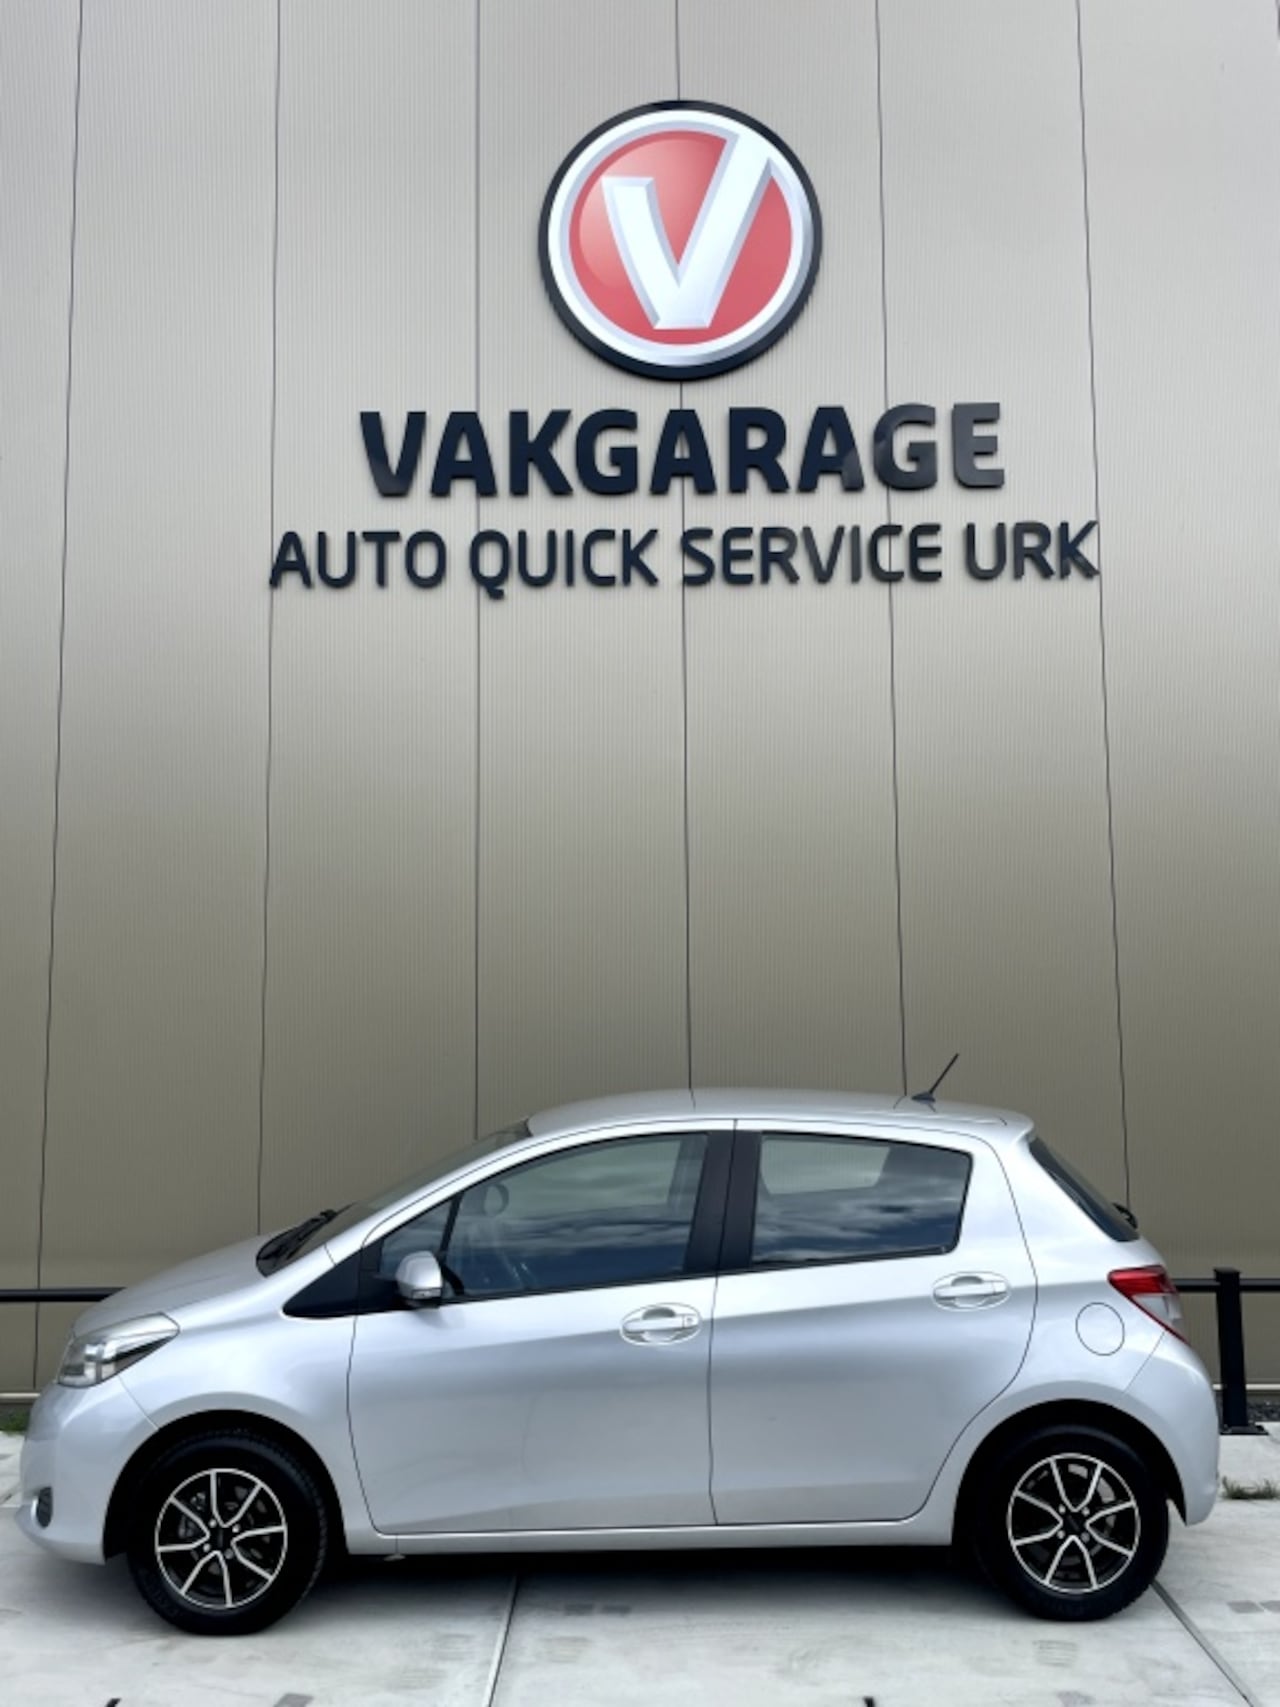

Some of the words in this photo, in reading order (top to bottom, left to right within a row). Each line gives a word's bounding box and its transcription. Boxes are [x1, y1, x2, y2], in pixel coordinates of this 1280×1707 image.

[601, 132, 772, 330] V
[360, 403, 1006, 499] VAKGARAGE
[269, 530, 448, 591] AUTO
[470, 528, 660, 601] QUICK
[681, 524, 944, 589] SERVICE
[964, 520, 1102, 584] URK
